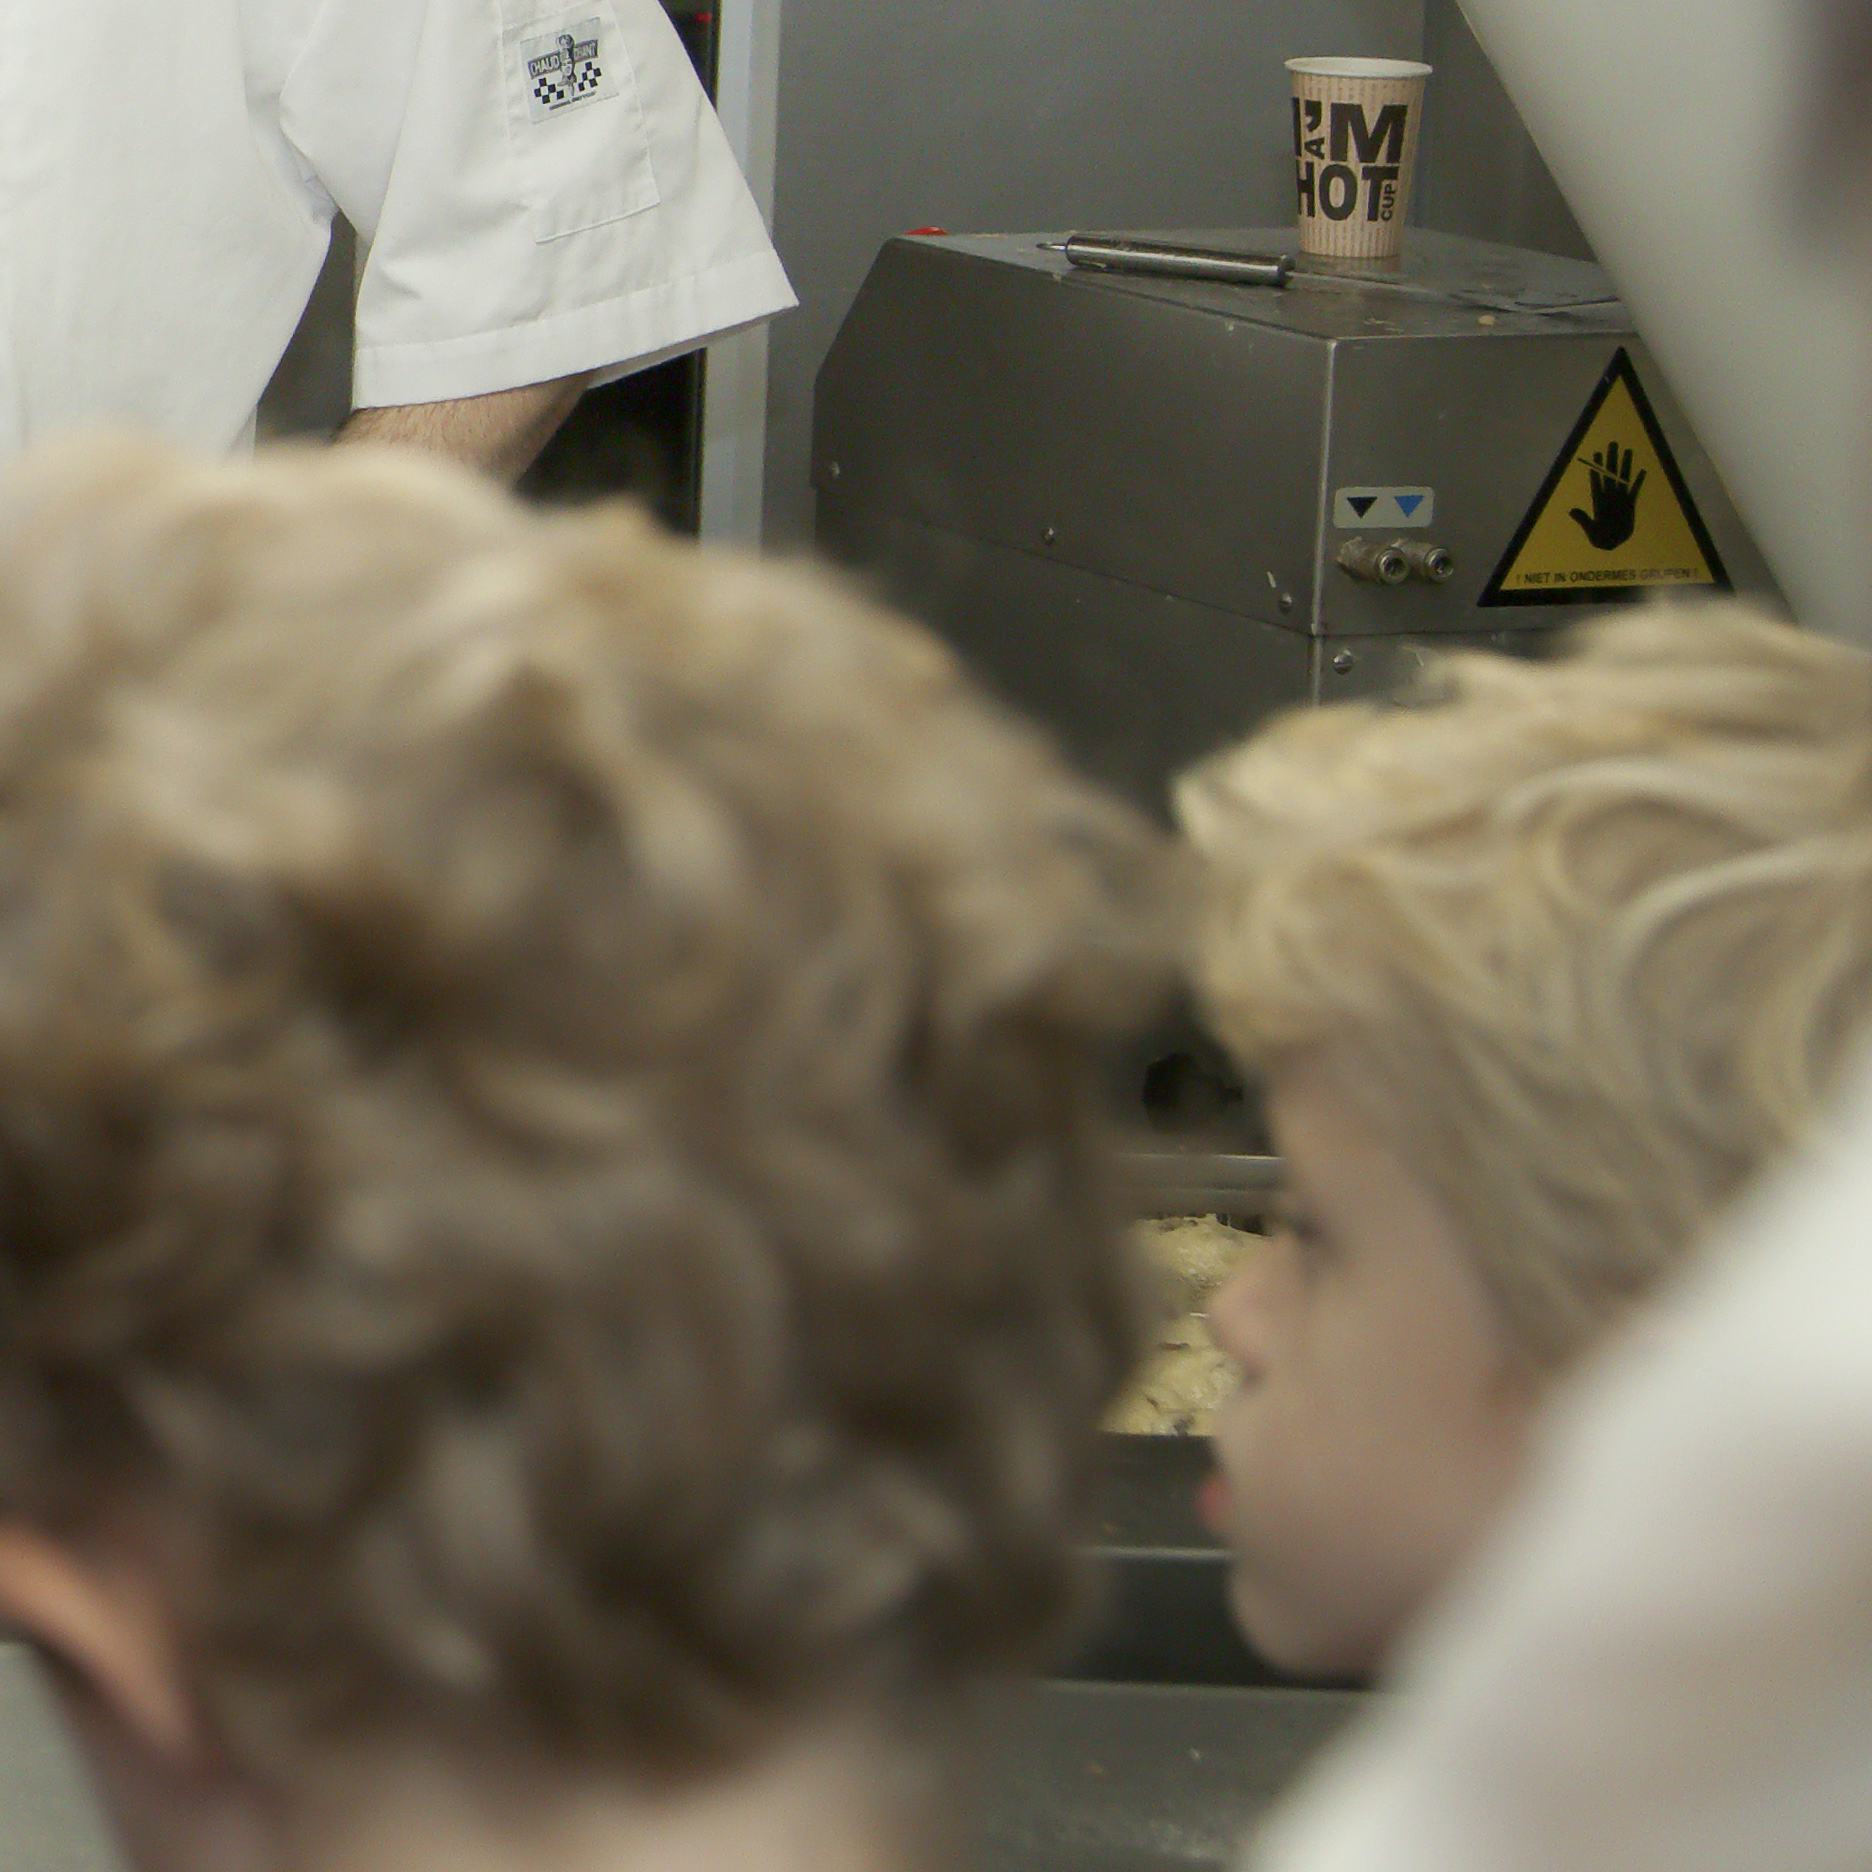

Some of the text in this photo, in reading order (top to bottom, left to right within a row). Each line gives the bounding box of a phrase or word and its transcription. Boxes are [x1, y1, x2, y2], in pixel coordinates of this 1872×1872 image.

[1296, 160, 1399, 222] HOT
[1381, 183, 1397, 221] CUP
[1523, 572, 1550, 585] NIET
